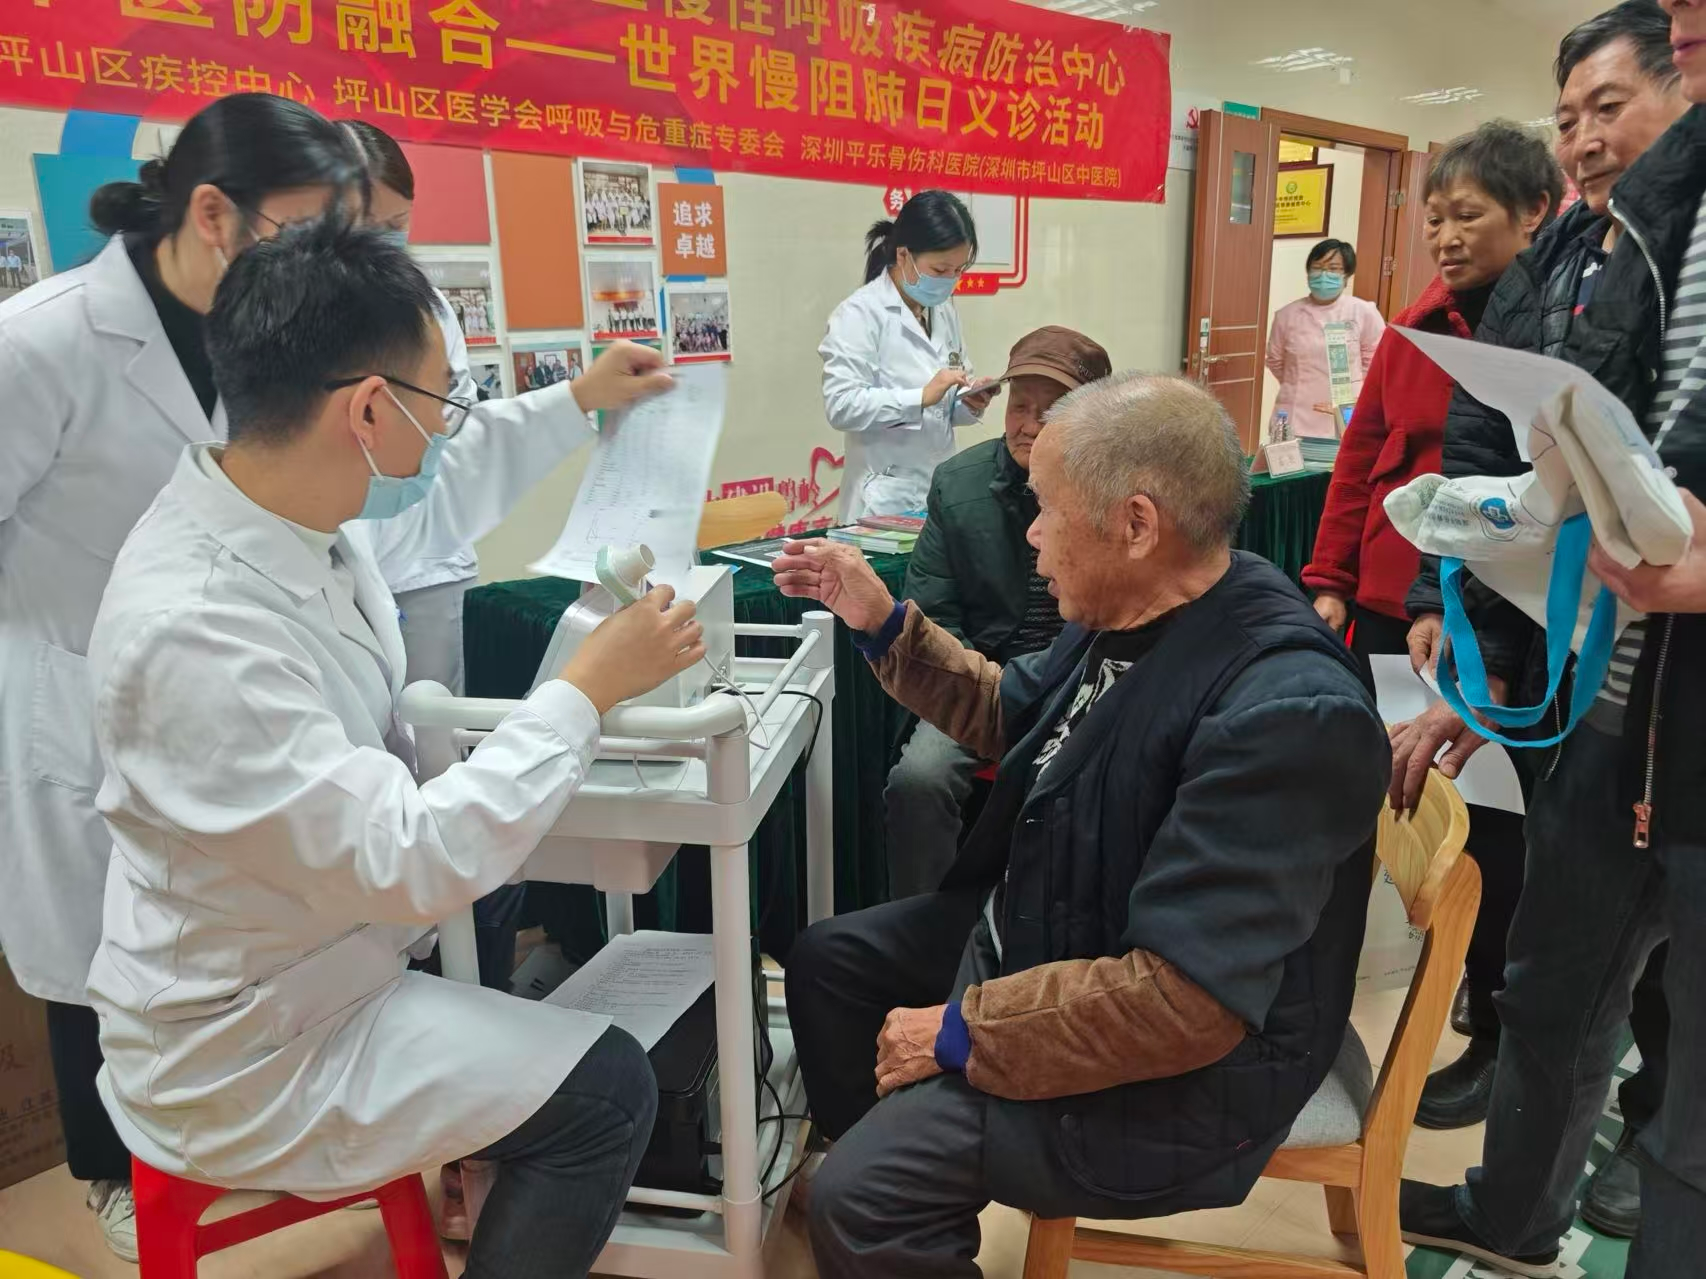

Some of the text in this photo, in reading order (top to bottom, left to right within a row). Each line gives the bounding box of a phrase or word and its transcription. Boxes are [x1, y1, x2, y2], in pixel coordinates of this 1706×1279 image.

[333, 76, 786, 158] 坪山区医学会呼吸与危重症专委会
[672, 200, 714, 228] 追求
[675, 232, 716, 259] 卓越
